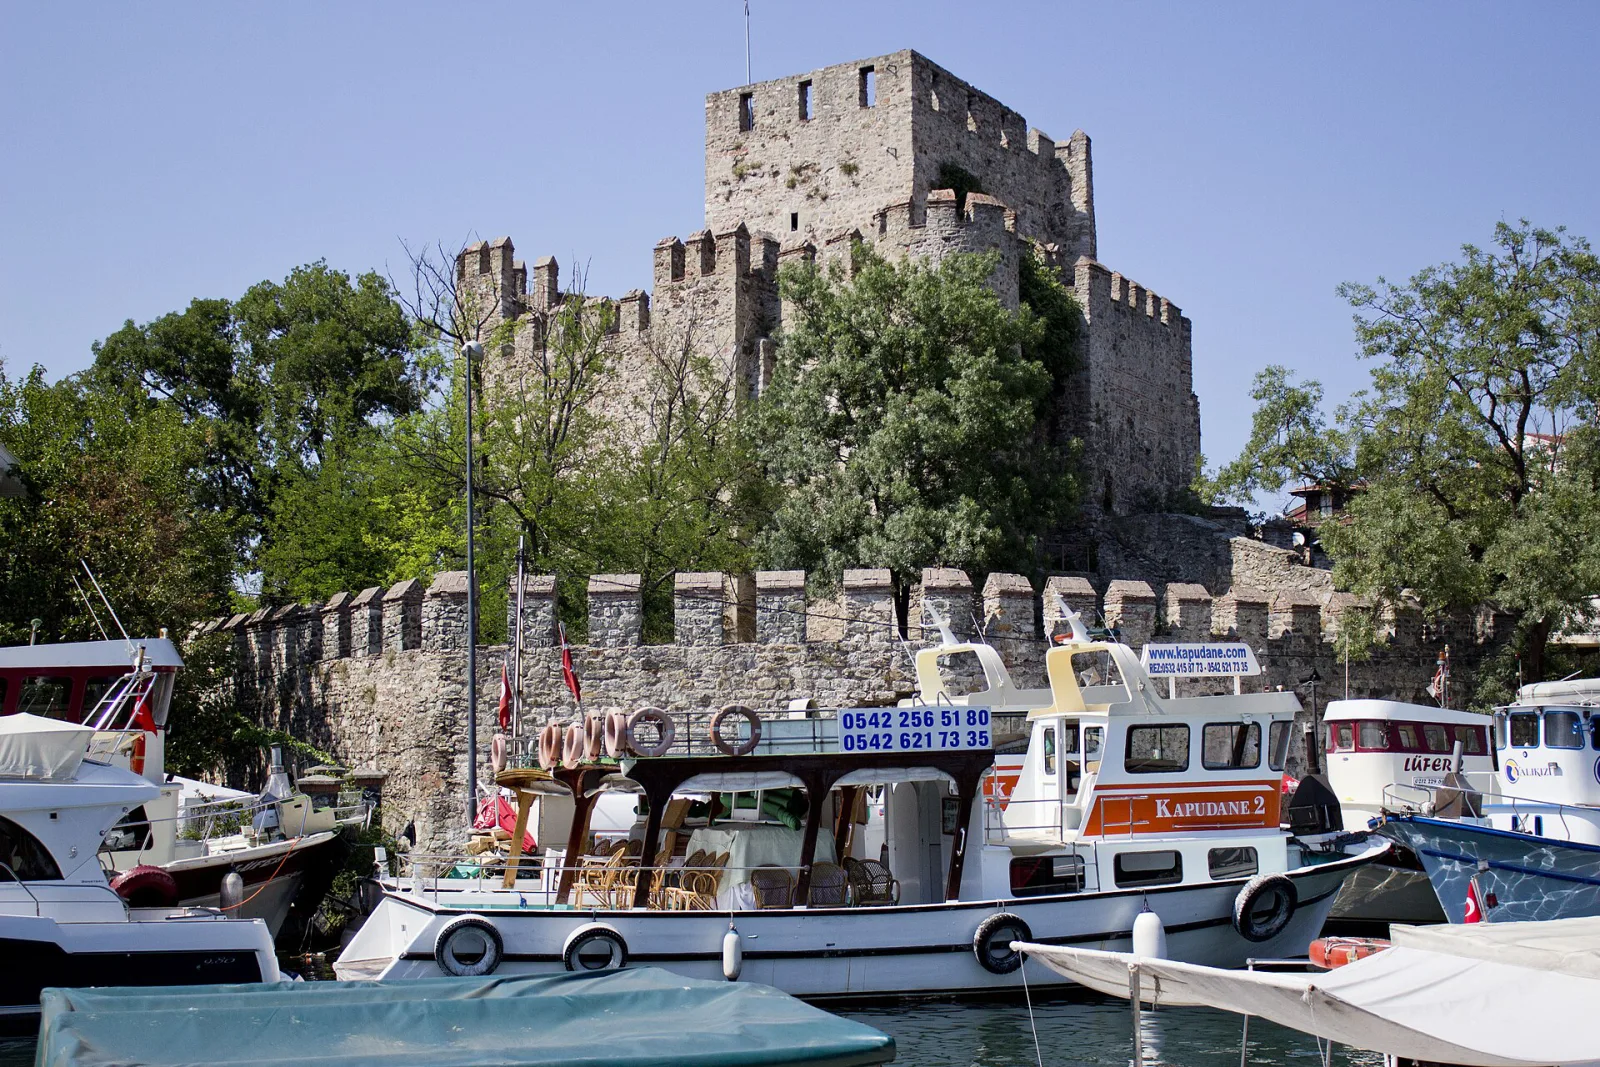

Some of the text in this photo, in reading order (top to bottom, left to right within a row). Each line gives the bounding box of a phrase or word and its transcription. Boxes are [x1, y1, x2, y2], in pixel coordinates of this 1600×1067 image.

[1149, 646, 1246, 662] www.kapudane.com
[1196, 663, 1204, 672] 73
[1208, 662, 1221, 672] 0542
[1222, 662, 1232, 672] 621
[1233, 662, 1240, 672] 73
[1241, 662, 1248, 672] 35
[843, 710, 989, 729] 0542 256 51 80
[843, 730, 989, 751] 0542 621 73 35
[1404, 755, 1452, 771] LÜFER
[1155, 796, 1266, 818] KAPUDANE 2
